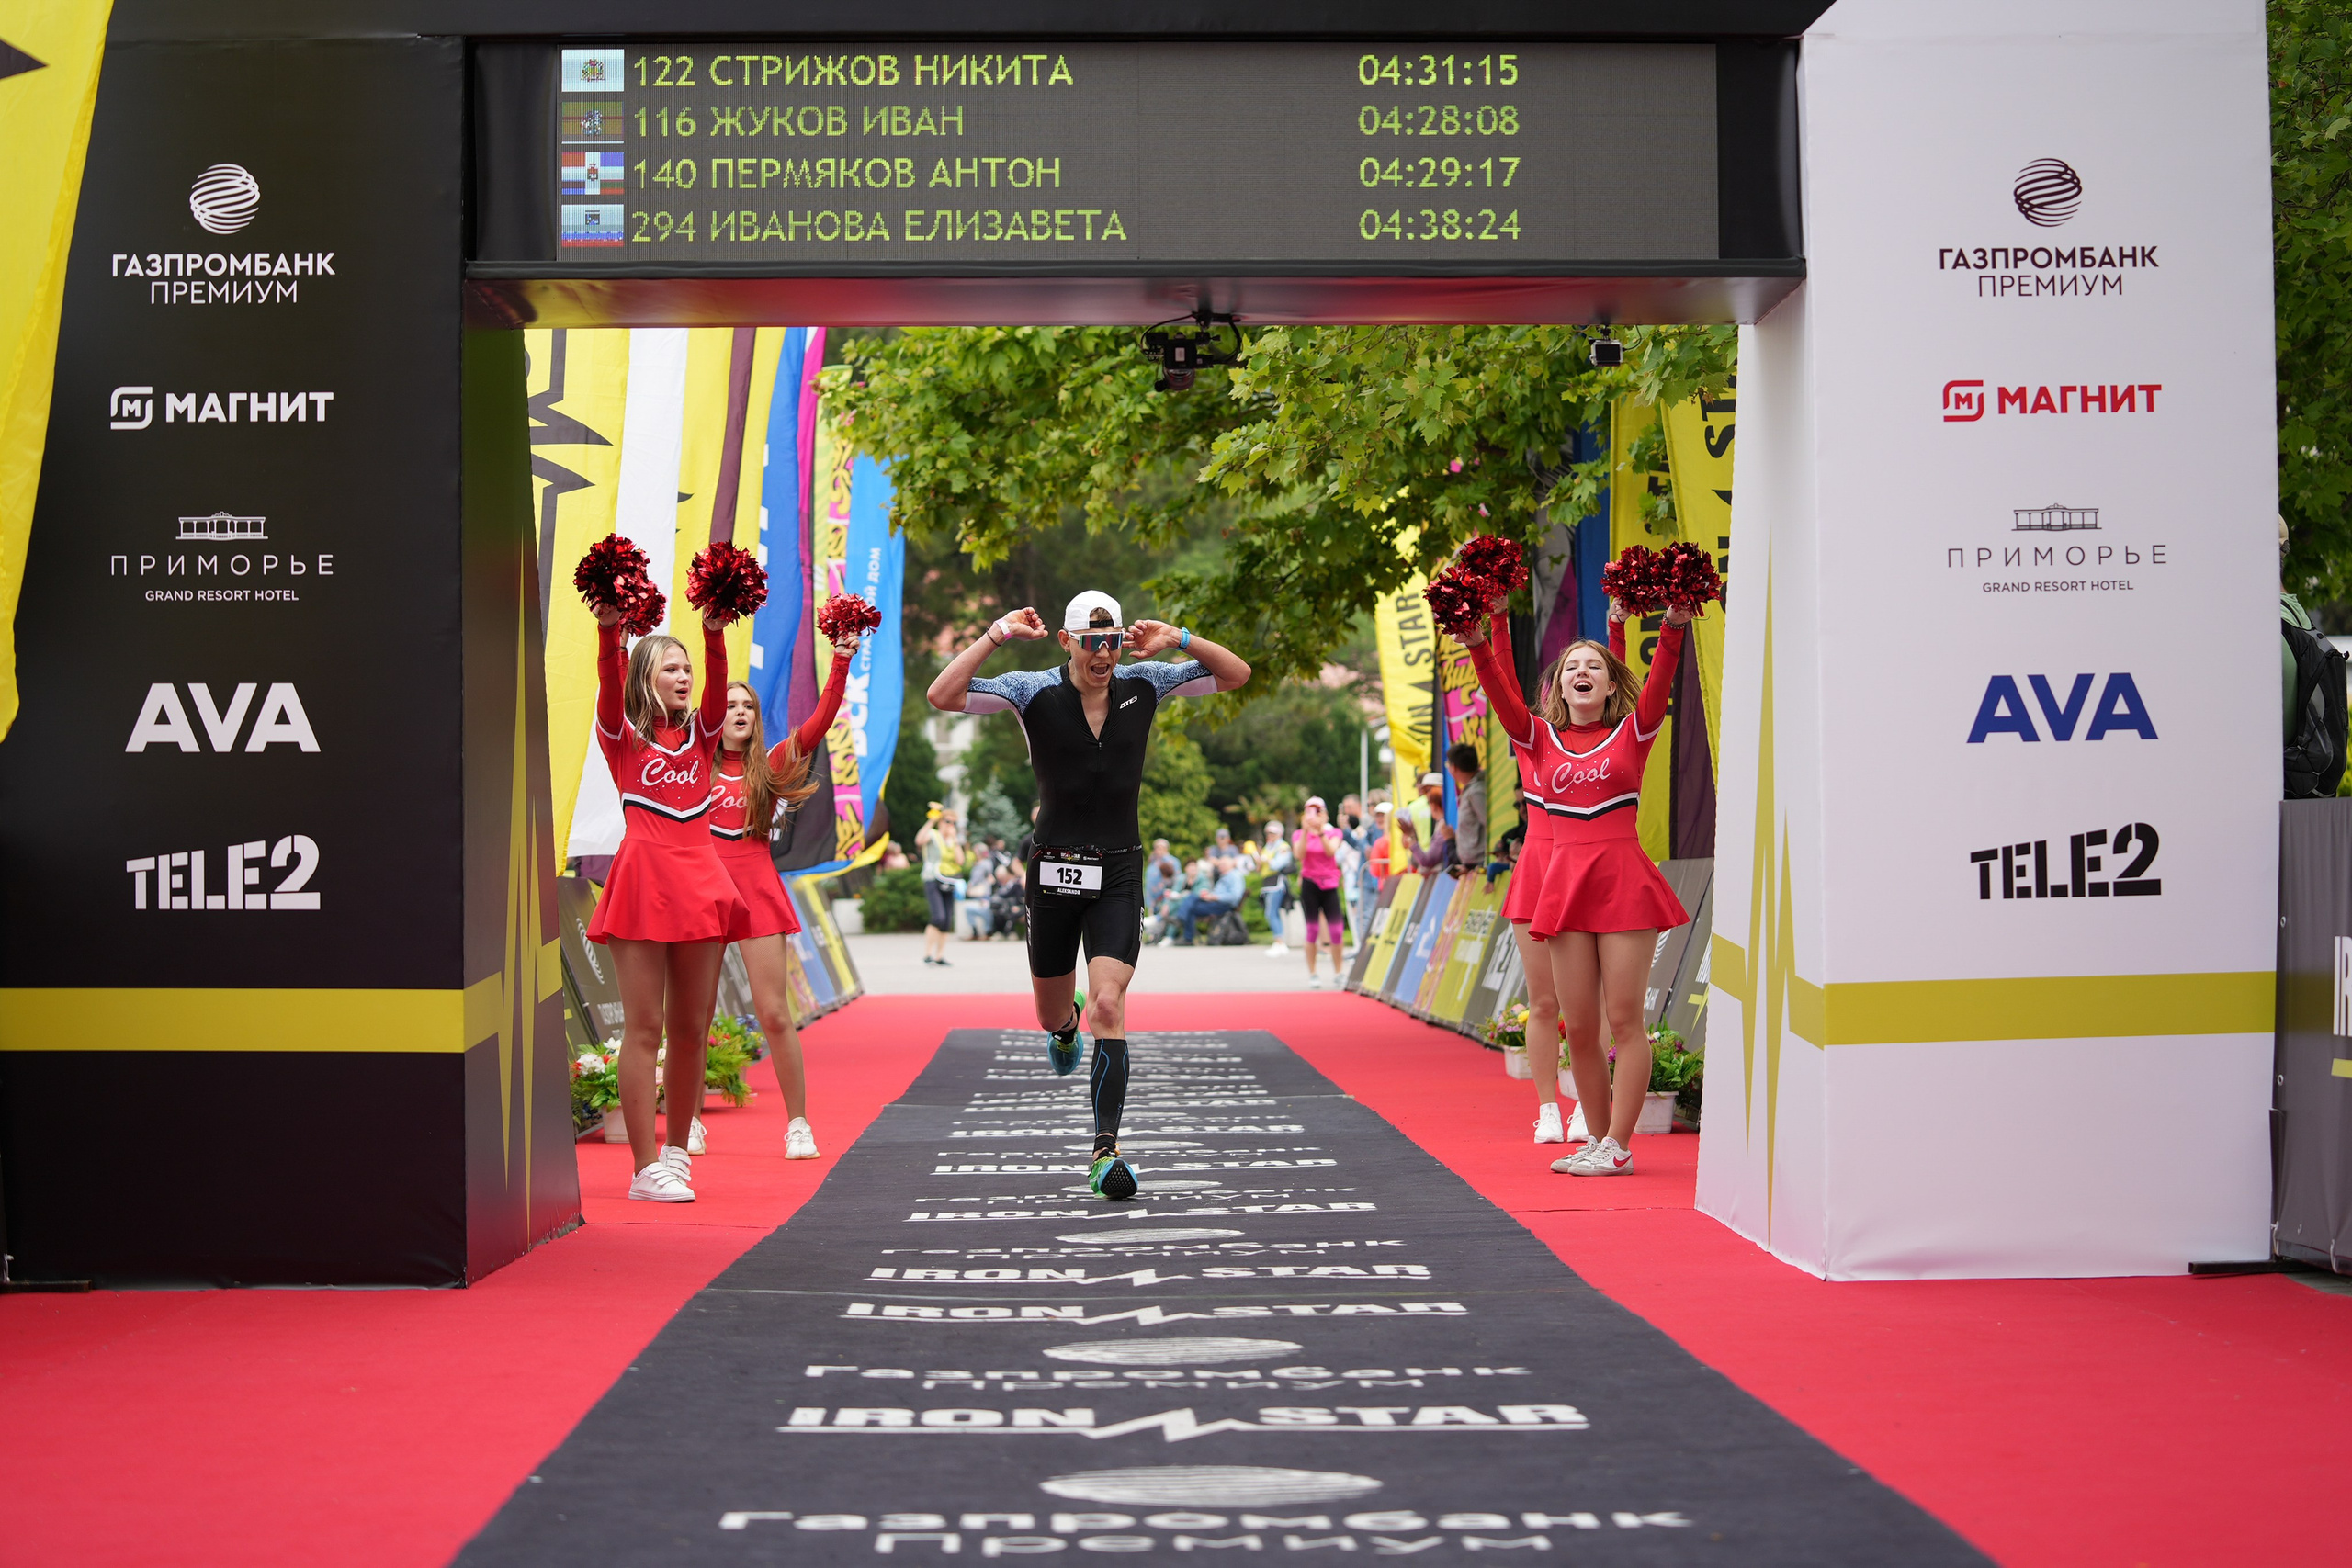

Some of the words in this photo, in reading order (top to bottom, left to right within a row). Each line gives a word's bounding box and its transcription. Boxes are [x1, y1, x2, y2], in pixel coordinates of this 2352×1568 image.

[636, 56, 695, 86] 122
[710, 55, 899, 85] СТРИЖОВ
[915, 54, 1073, 85] НИКИТА
[1359, 54, 1518, 85] 04:31:15
[636, 107, 695, 136] 116
[711, 106, 848, 136] ЖУКОВ
[864, 106, 963, 135] ИВАН
[1359, 105, 1519, 135] 04:28:08
[635, 159, 696, 188] 140
[712, 158, 915, 188] ПЕРМЯКОВ
[929, 157, 1060, 187] АНТОН
[1360, 157, 1521, 187] 04:29:17
[633, 211, 695, 242] 294
[711, 210, 890, 241] ИВАНОВА
[906, 209, 1126, 241] ЕЛИЗАВЕТА
[1360, 209, 1521, 240] 04:38:24
[113, 253, 334, 276] ГАЗПРОМБАНК
[1939, 246, 2158, 269] ГАЗПРОМБАНК
[152, 281, 297, 304] ПРЕМИУМ
[1979, 275, 2121, 297] ПРЕМИУМ
[166, 392, 334, 422] МАГНИТ
[1998, 385, 2162, 414] МАГНИТ
[112, 555, 333, 575] ПРИМОРЬЕ
[867, 547, 882, 584] ДОМ
[1949, 545, 2165, 567] ПРИМОРЬЕ
[146, 591, 193, 601] GRAND
[198, 591, 250, 601] RESORT
[255, 590, 299, 600] HOTEL
[1983, 582, 2030, 592] GRAND
[2035, 581, 2086, 591] RESORT
[2091, 581, 2133, 590] HOTEL
[1396, 592, 1433, 668] STAR
[126, 683, 321, 752] AVA
[1967, 672, 2158, 743] AVA
[642, 757, 699, 786] Cool
[1551, 757, 1611, 794] Cool
[710, 785, 747, 812] Coo
[127, 835, 320, 909] TELE2
[1971, 823, 2161, 899] TELE2
[1057, 867, 1082, 885] 152
[909, 1210, 1089, 1219] IRON
[1186, 1202, 1378, 1213] STAR
[871, 1268, 1085, 1279] IRON
[1202, 1265, 1430, 1278] STAR
[846, 1303, 1084, 1318] IRON
[1213, 1303, 1467, 1316] STAR
[805, 1365, 1532, 1381] Газпромбанк
[787, 1407, 1095, 1427] IRON
[1258, 1404, 1589, 1426] STAR
[719, 1510, 1694, 1534] Газпромбанк
[873, 1532, 1553, 1558] Премиум
